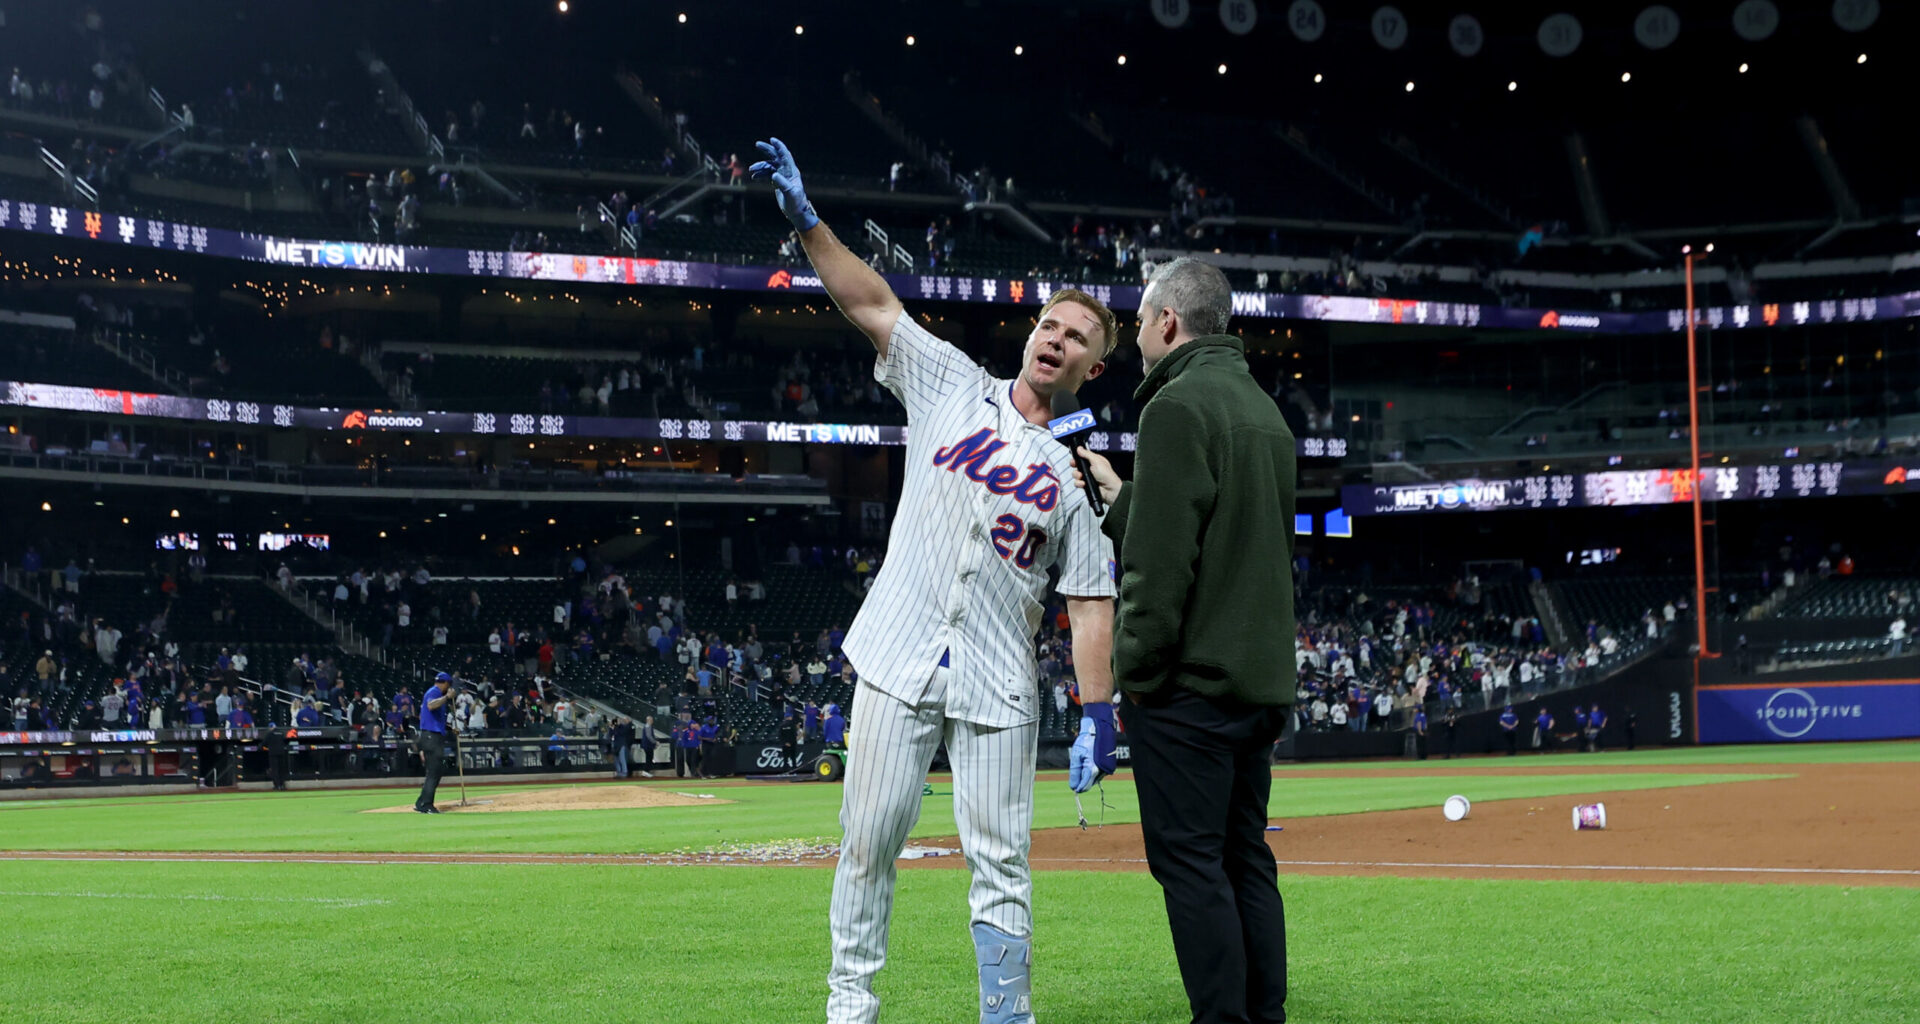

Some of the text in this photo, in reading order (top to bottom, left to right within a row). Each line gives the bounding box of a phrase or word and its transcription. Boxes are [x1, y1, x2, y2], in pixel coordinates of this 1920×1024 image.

[1229, 2, 1248, 23] 16
[1295, 8, 1317, 30] 24
[1381, 18, 1398, 38] 17
[265, 240, 405, 266] METS WIN
[368, 415, 423, 427] moomoo
[1052, 414, 1089, 436] SNY
[767, 423, 880, 443] METS WIN
[933, 427, 1060, 512] Mets
[1395, 486, 1505, 506] METS WIN
[990, 513, 1047, 569] 20
[1756, 705, 1863, 719] 1POINTFIVE
[91, 731, 155, 742] METS WIN
